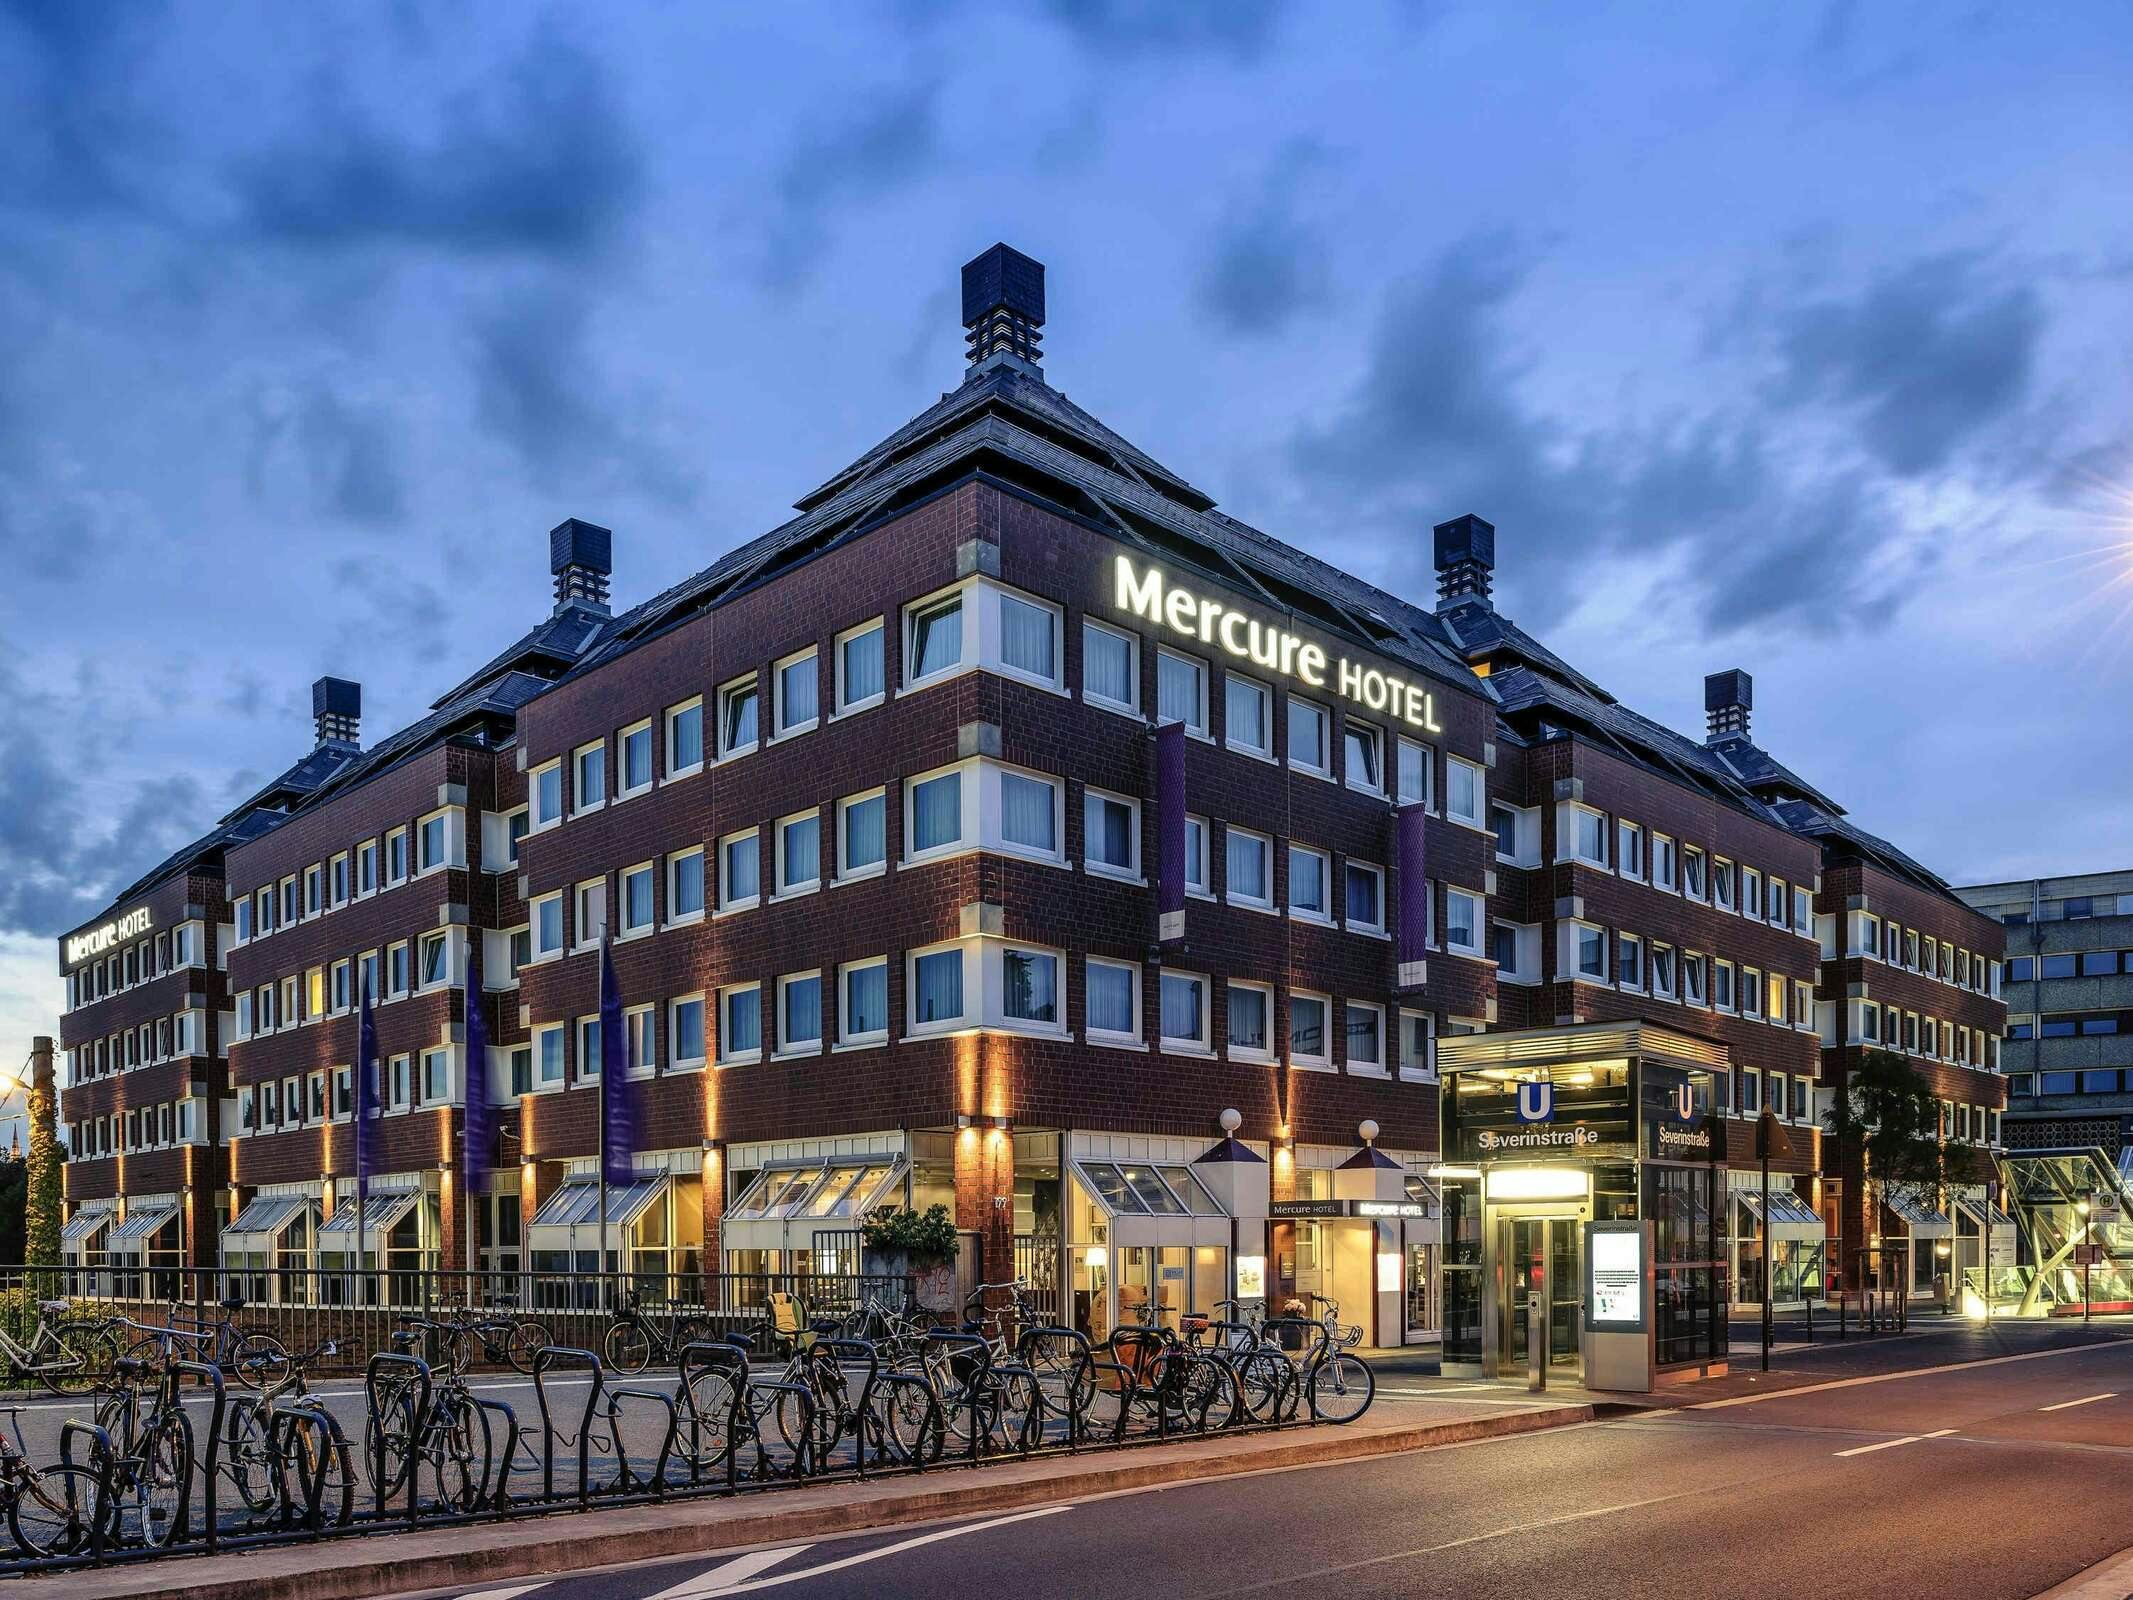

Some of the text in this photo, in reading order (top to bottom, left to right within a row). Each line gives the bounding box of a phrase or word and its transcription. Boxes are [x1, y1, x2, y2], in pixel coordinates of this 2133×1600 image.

[1114, 555, 1442, 733] Mercure HOTEL
[68, 906, 154, 964] Mercure HOTEL
[1520, 1083, 1550, 1120] U
[1679, 1083, 1693, 1120] U
[1478, 1126, 1599, 1151] Severinstraße
[1659, 1125, 1710, 1148] Severinstraße
[1274, 1205, 1337, 1215] Mercure HOTEL
